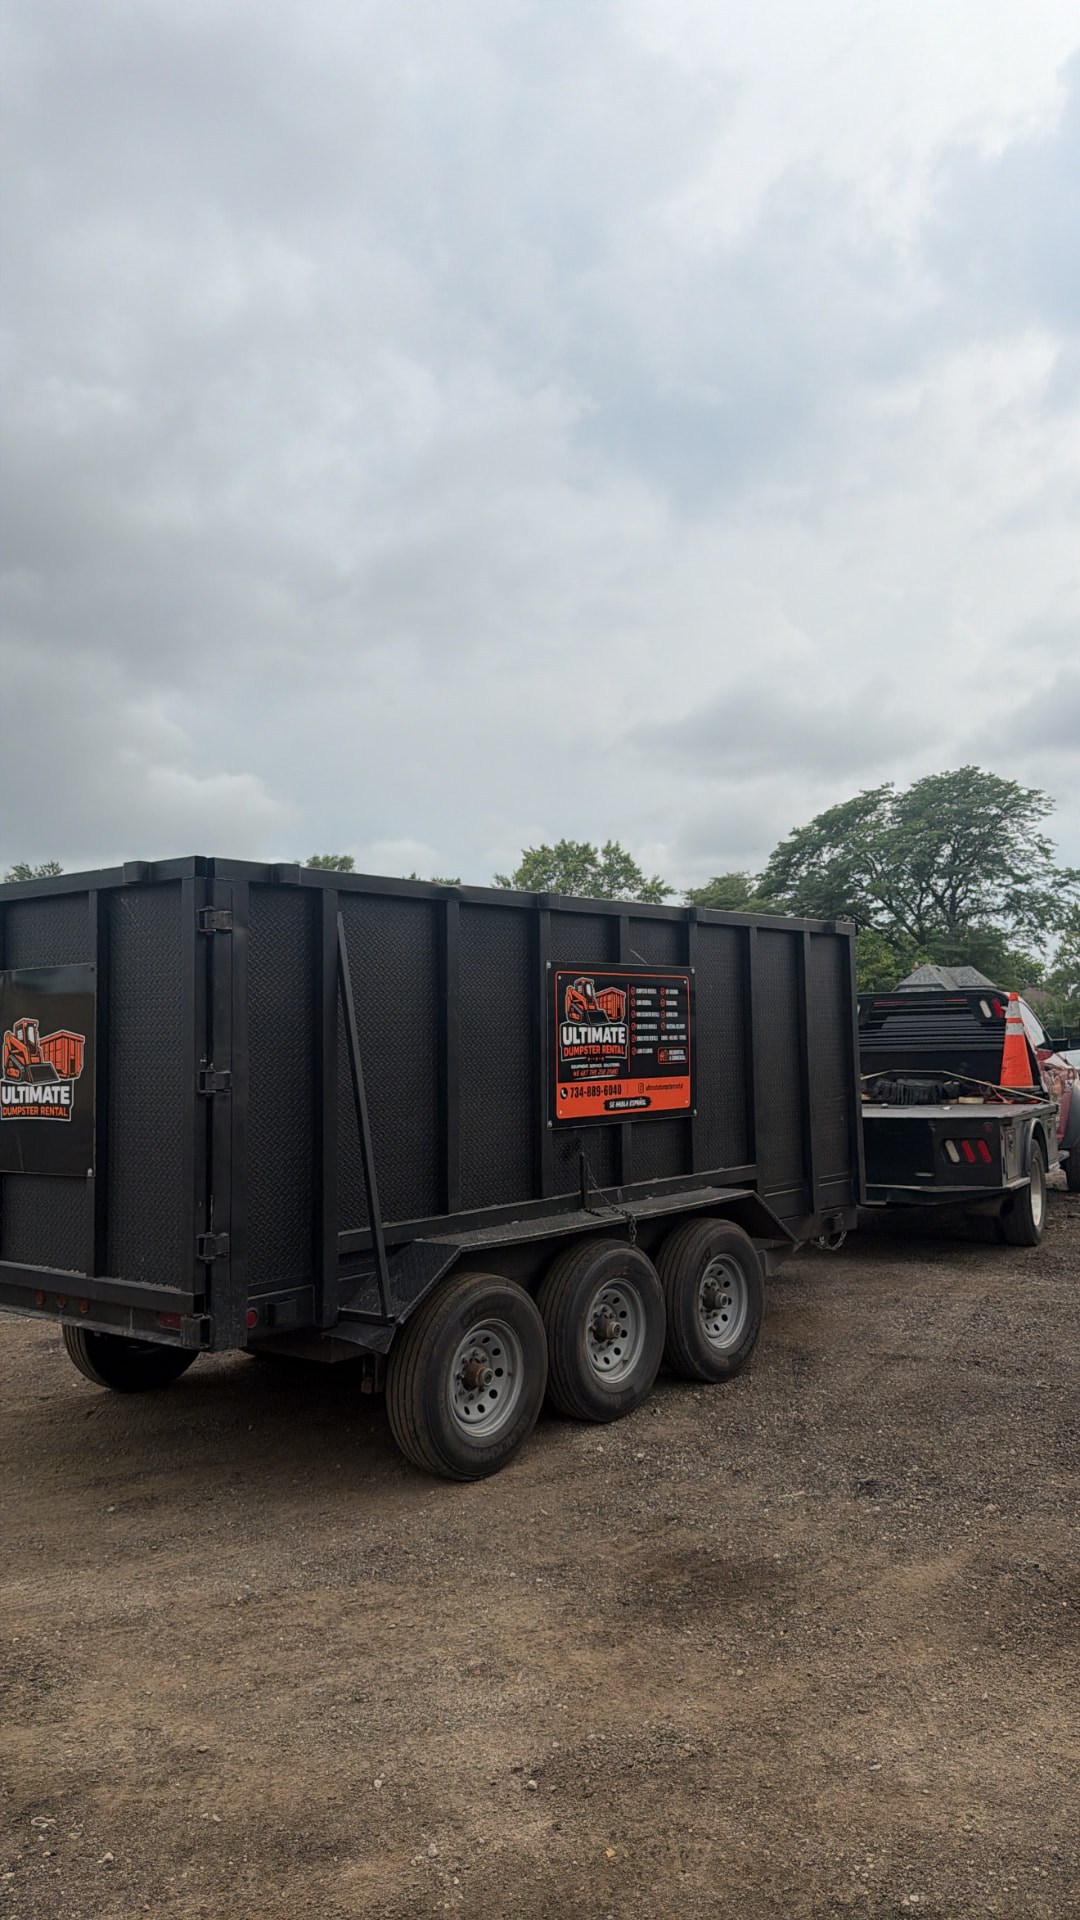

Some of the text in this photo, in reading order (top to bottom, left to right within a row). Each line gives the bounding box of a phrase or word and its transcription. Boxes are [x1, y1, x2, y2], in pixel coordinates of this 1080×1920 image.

[563, 1027, 625, 1045] ULTIMATE
[563, 1046, 600, 1057] DUMPSTER
[601, 1045, 625, 1055] RENTAL
[2, 1086, 70, 1104] ULTIMATE
[570, 1084, 621, 1098] 734-889-6040
[2, 1106, 68, 1117] DUMPSTER RENTAL
